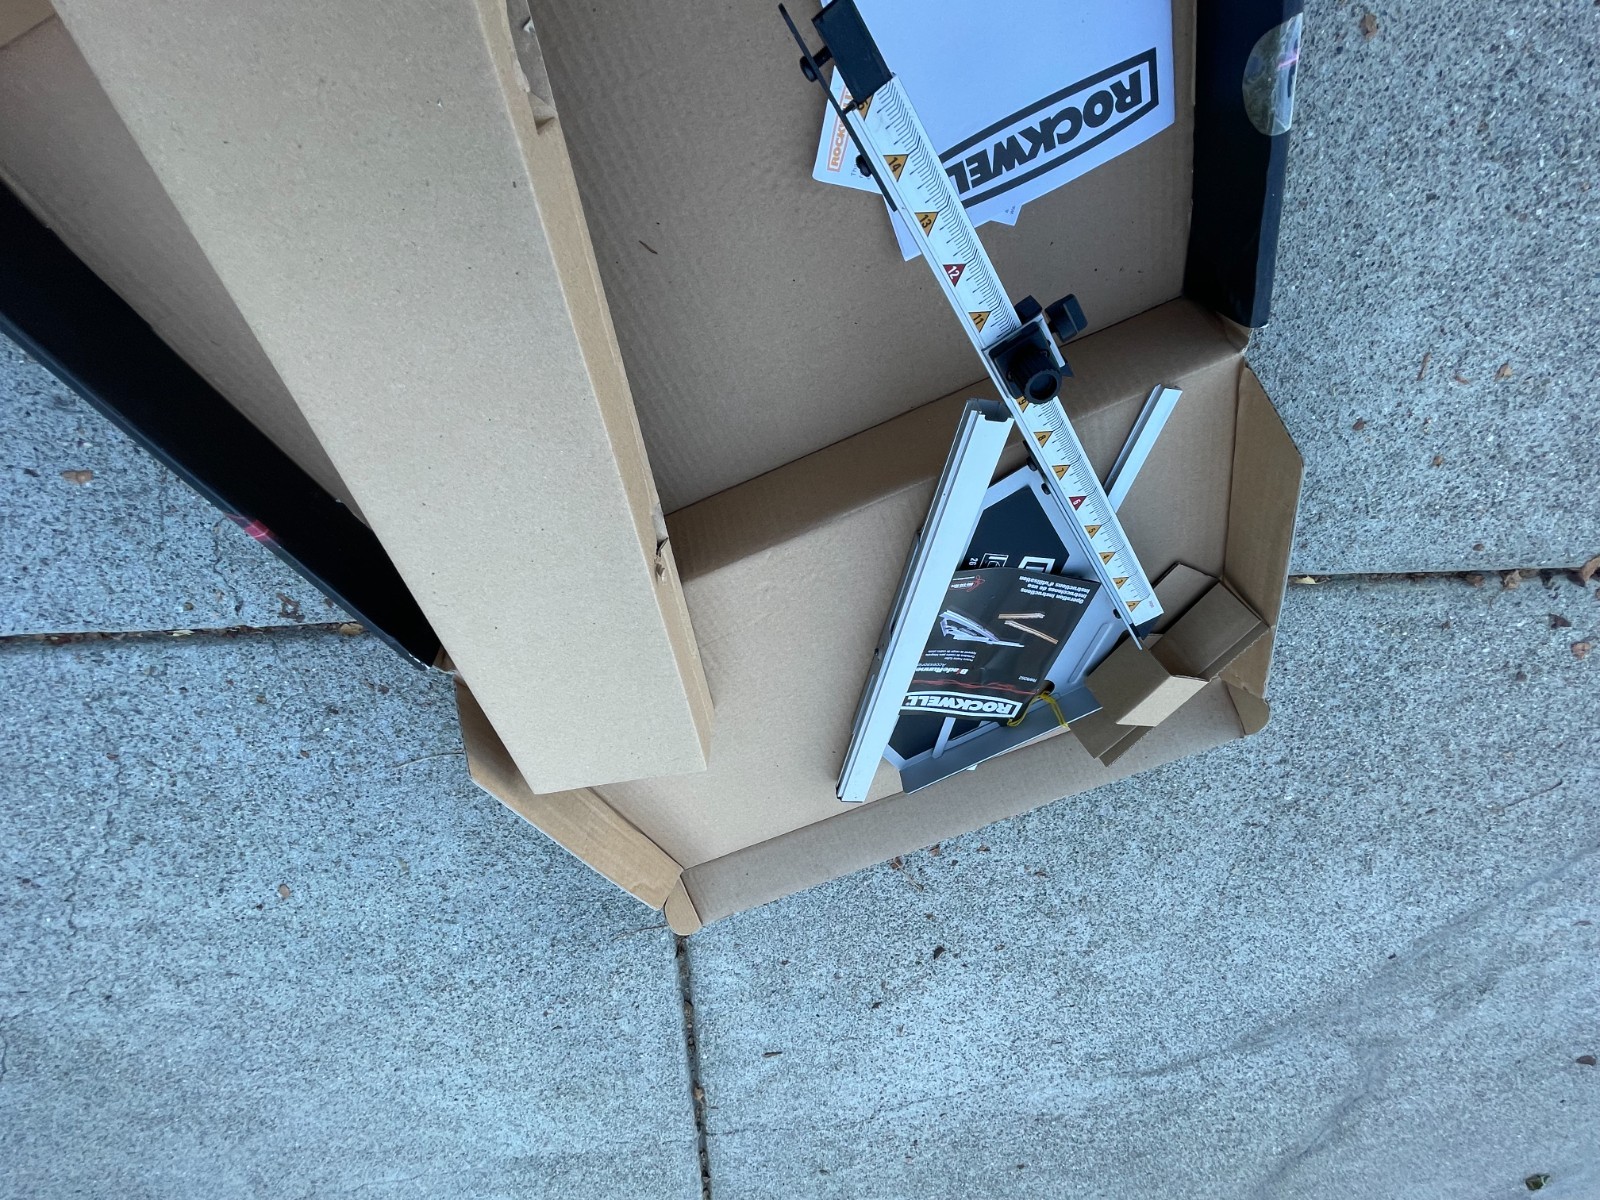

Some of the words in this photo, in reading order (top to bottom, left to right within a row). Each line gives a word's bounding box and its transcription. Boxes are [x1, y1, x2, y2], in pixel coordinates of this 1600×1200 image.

[945, 69, 1142, 195] ROCKWEL
[888, 156, 901, 173] 14
[919, 214, 932, 229] 13
[948, 265, 960, 280] 12
[972, 313, 984, 326] 11
[1037, 434, 1047, 442] 8
[1055, 594, 1084, 605] Operation
[915, 667, 969, 675] BladeRunne
[906, 695, 1013, 714] ROCKWELL
